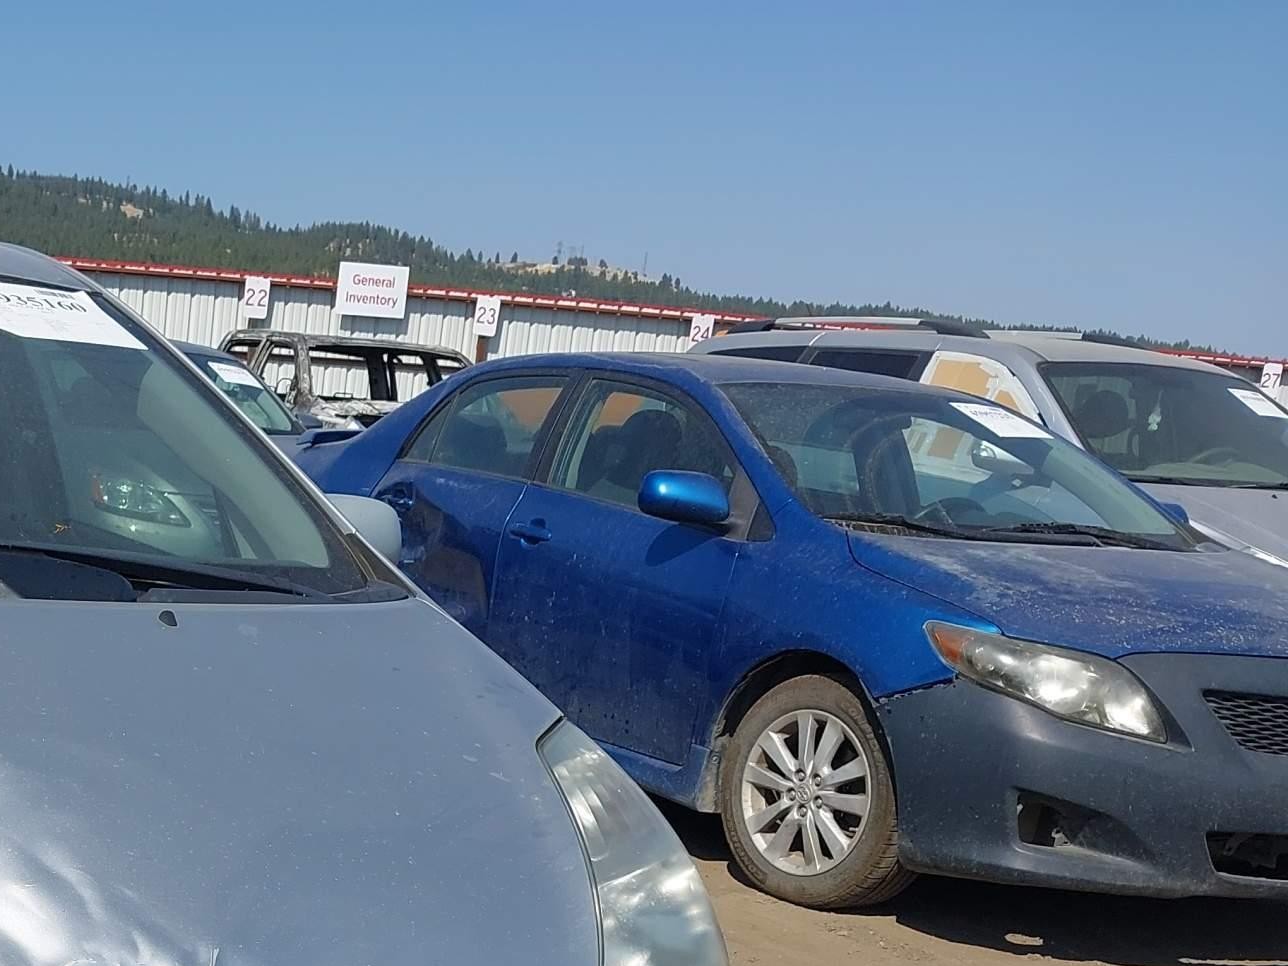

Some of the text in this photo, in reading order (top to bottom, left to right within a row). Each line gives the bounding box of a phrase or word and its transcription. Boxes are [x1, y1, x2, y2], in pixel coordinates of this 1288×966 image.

[352, 273, 396, 289] General
[245, 288, 268, 308] 22
[345, 291, 399, 309] Inventory
[477, 306, 497, 325] 23
[691, 325, 711, 342] 24
[1261, 372, 1281, 389] 27
